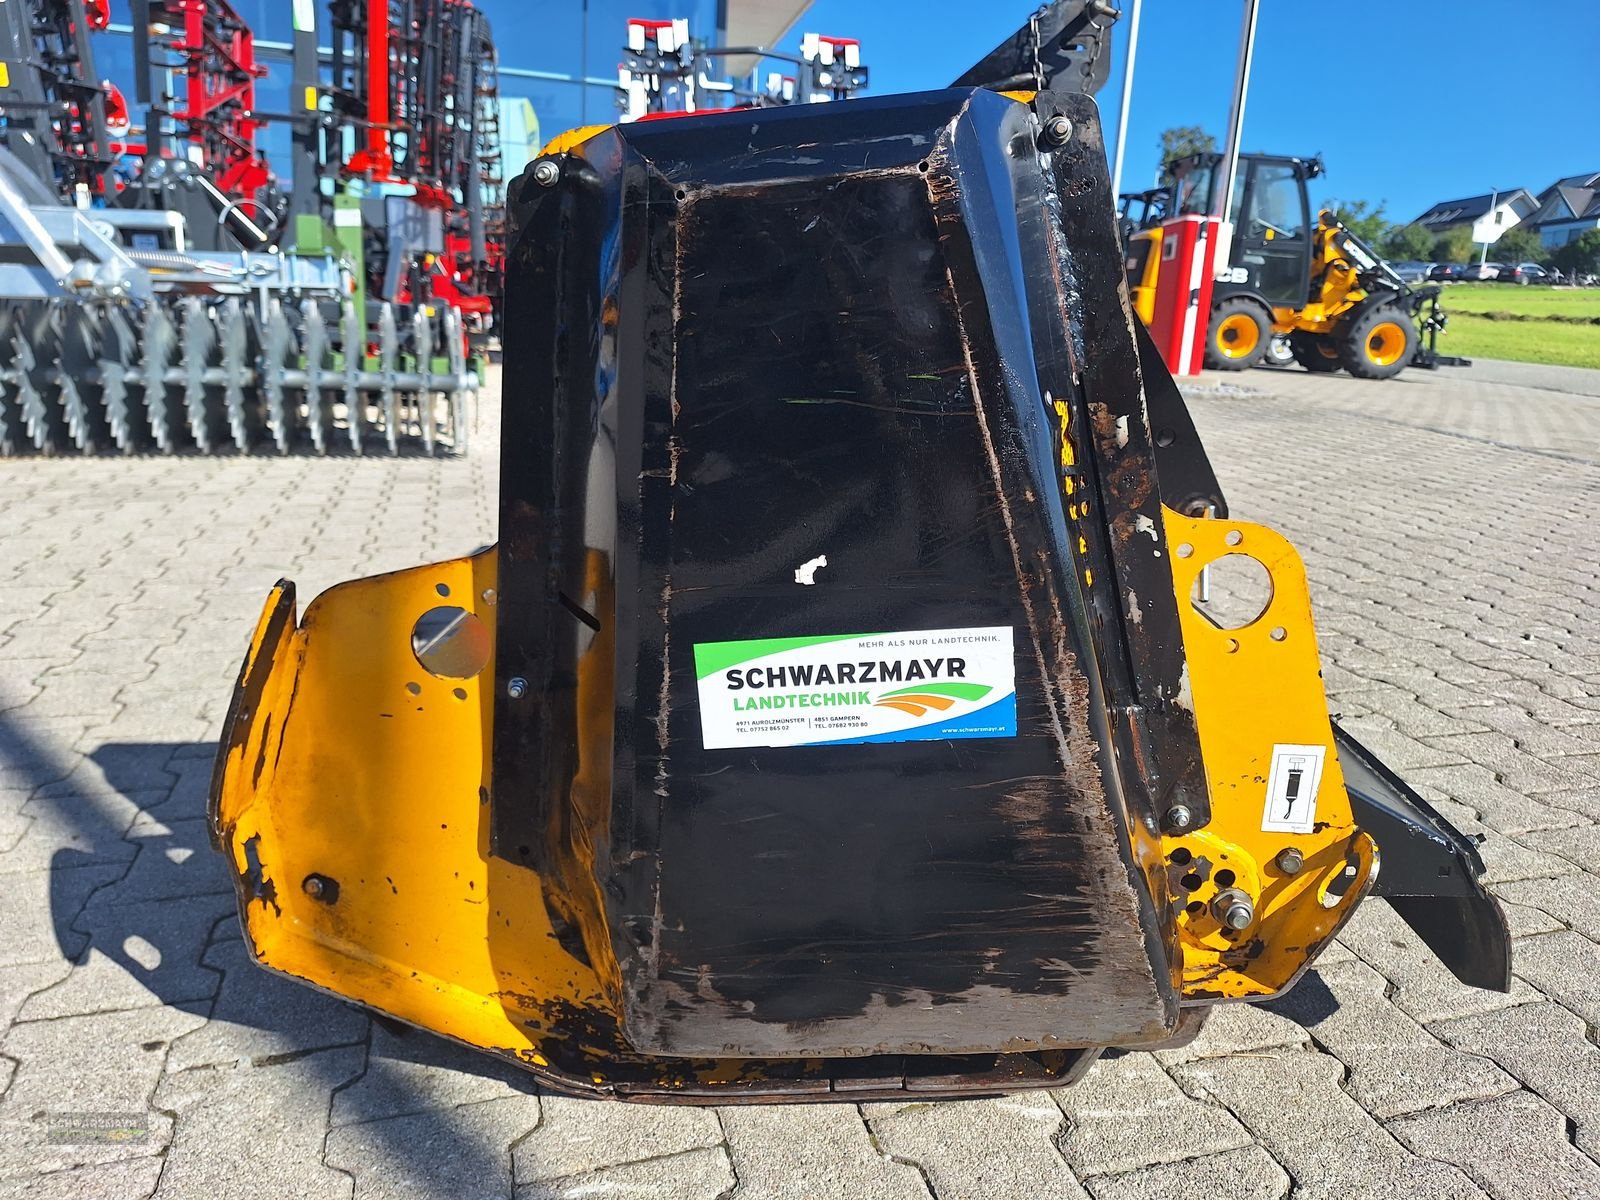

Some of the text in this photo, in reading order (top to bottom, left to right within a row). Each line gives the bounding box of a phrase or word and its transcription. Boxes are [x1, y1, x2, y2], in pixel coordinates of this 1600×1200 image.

[1214, 268, 1248, 284] CB
[858, 634, 1001, 649] MEHR ALS NUR LANDTECHNIK.
[726, 658, 966, 690] SCHWARZMAYR
[734, 691, 871, 711] LANDTECHNIK
